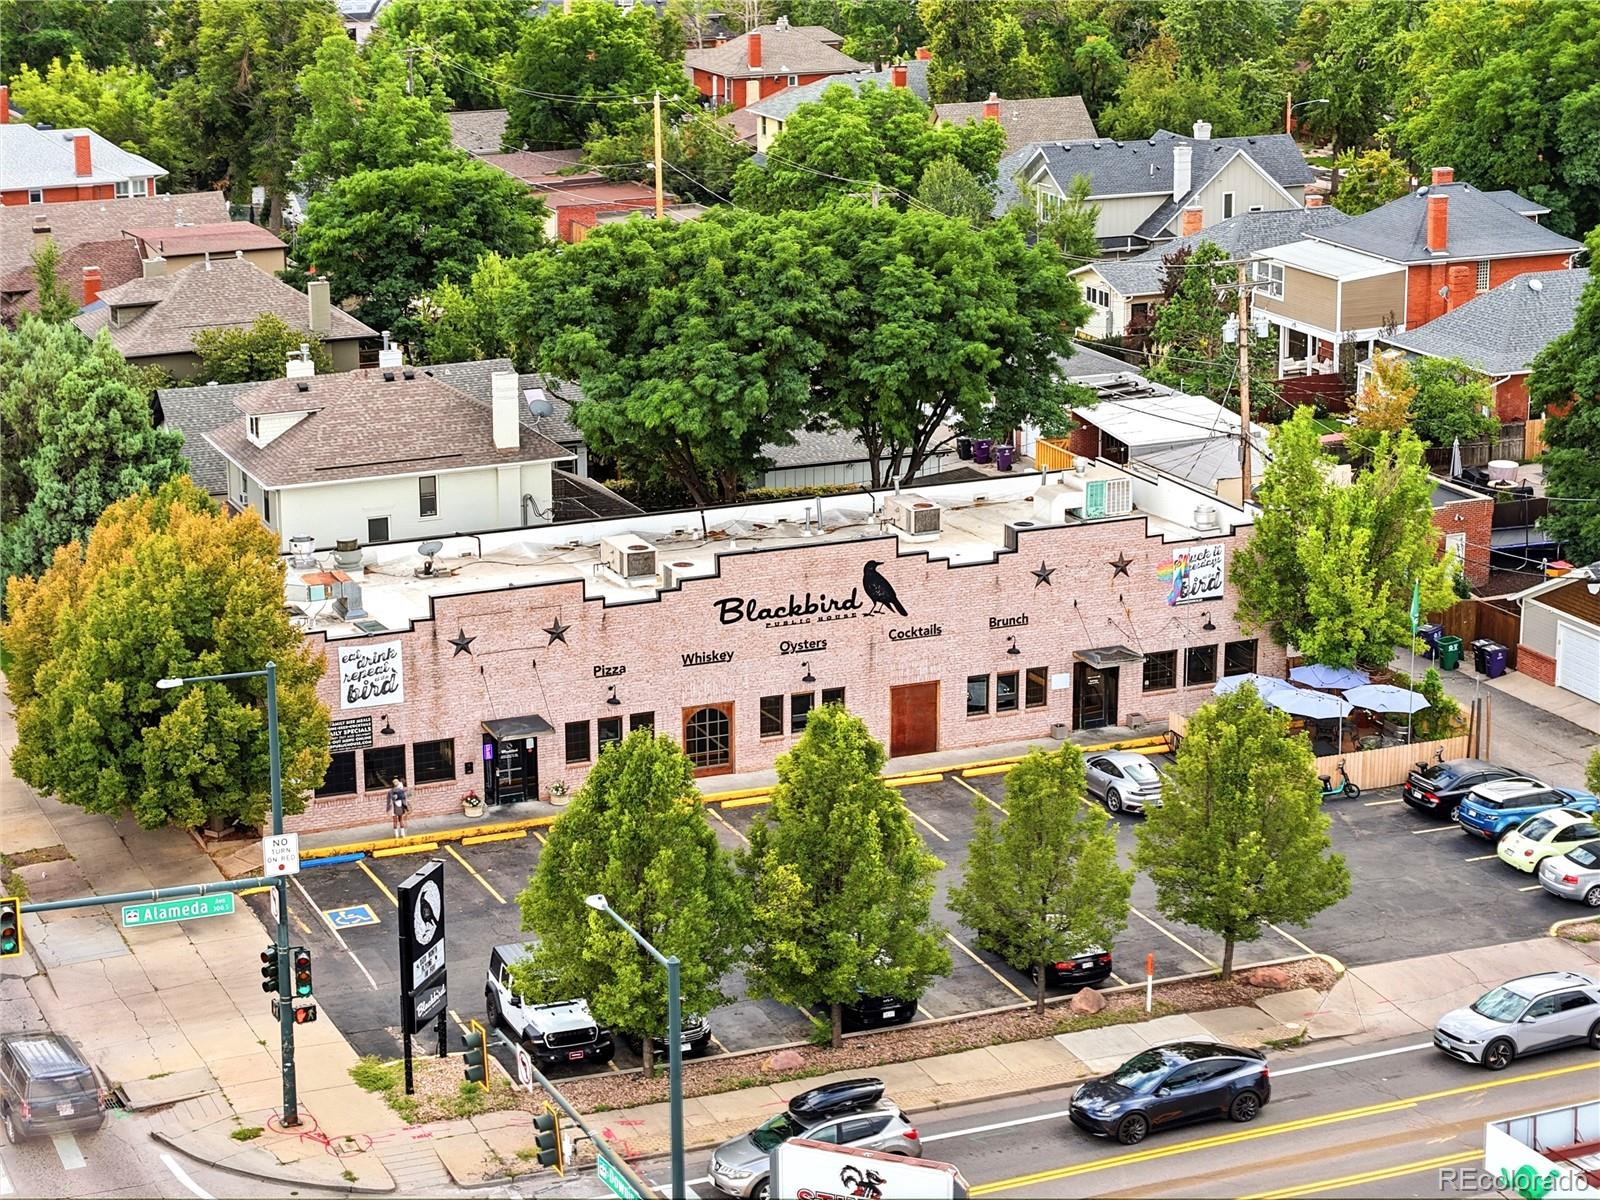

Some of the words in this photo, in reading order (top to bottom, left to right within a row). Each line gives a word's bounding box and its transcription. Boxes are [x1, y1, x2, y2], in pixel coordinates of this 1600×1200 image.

[1180, 571, 1222, 599] bird
[713, 587, 863, 625] Blackbird
[765, 617, 811, 629] PUBLIC
[816, 612, 857, 623] HOUSE
[989, 612, 1029, 630] Brunch
[888, 623, 942, 641] Cocktails
[779, 637, 828, 655] Oysters
[342, 649, 361, 664] eat
[357, 647, 398, 669] drink
[681, 650, 735, 667] Whiskey
[343, 661, 391, 684] repeat
[593, 663, 626, 678] Pizza
[347, 672, 399, 704] bird
[343, 726, 372, 735] SPECIALS
[272, 838, 288, 847] NO
[272, 847, 291, 855] TURN
[267, 856, 278, 864] ON
[280, 854, 296, 862] RED
[143, 900, 209, 922] Alameda
[416, 983, 447, 1018] Blackbird
